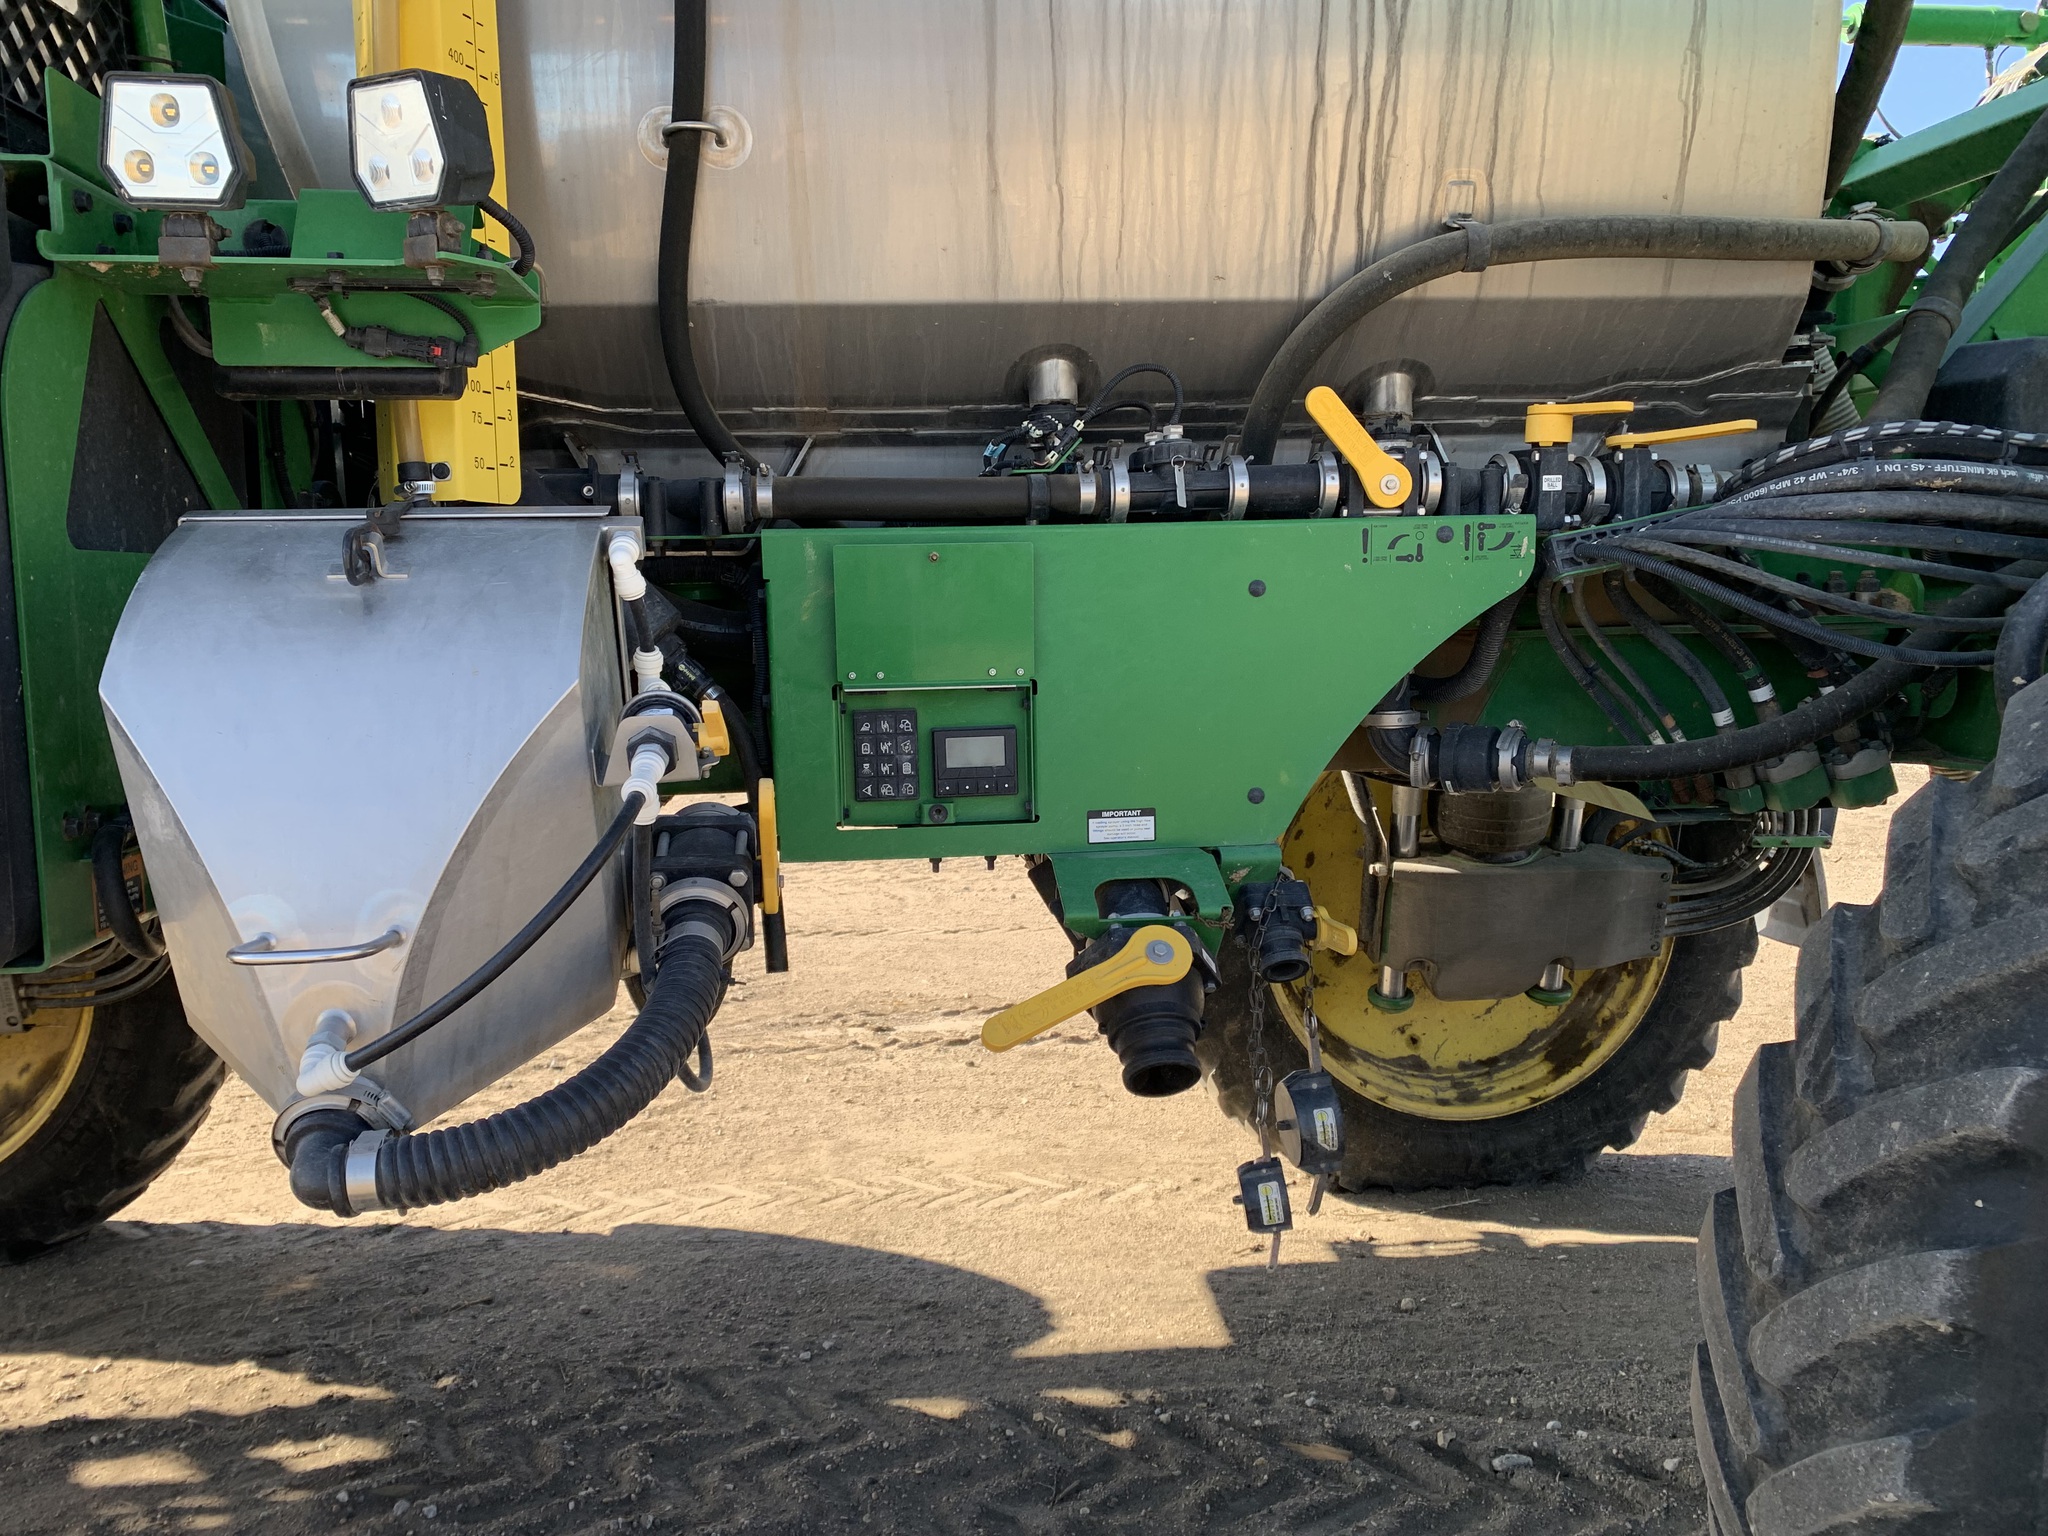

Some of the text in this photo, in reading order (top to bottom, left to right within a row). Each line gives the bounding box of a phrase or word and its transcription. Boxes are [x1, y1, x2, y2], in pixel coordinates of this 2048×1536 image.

[448, 47, 464, 66] 400
[490, 71, 500, 86] 15
[505, 380, 511, 392] 4
[471, 411, 482, 424] 75
[507, 409, 513, 422] 3
[474, 457, 485, 470] 50
[509, 456, 515, 468] 2
[1884, 463, 1901, 472] DN
[1911, 463, 1925, 472] 4S
[1934, 463, 1985, 475] MINETUFF
[1986, 467, 1999, 477] 6K
[1793, 476, 1806, 485] 42
[1808, 471, 1827, 481] WP
[1769, 479, 1791, 490] MPa
[1743, 486, 1768, 501] (6000
[1101, 809, 1142, 818] IMPORTANT
